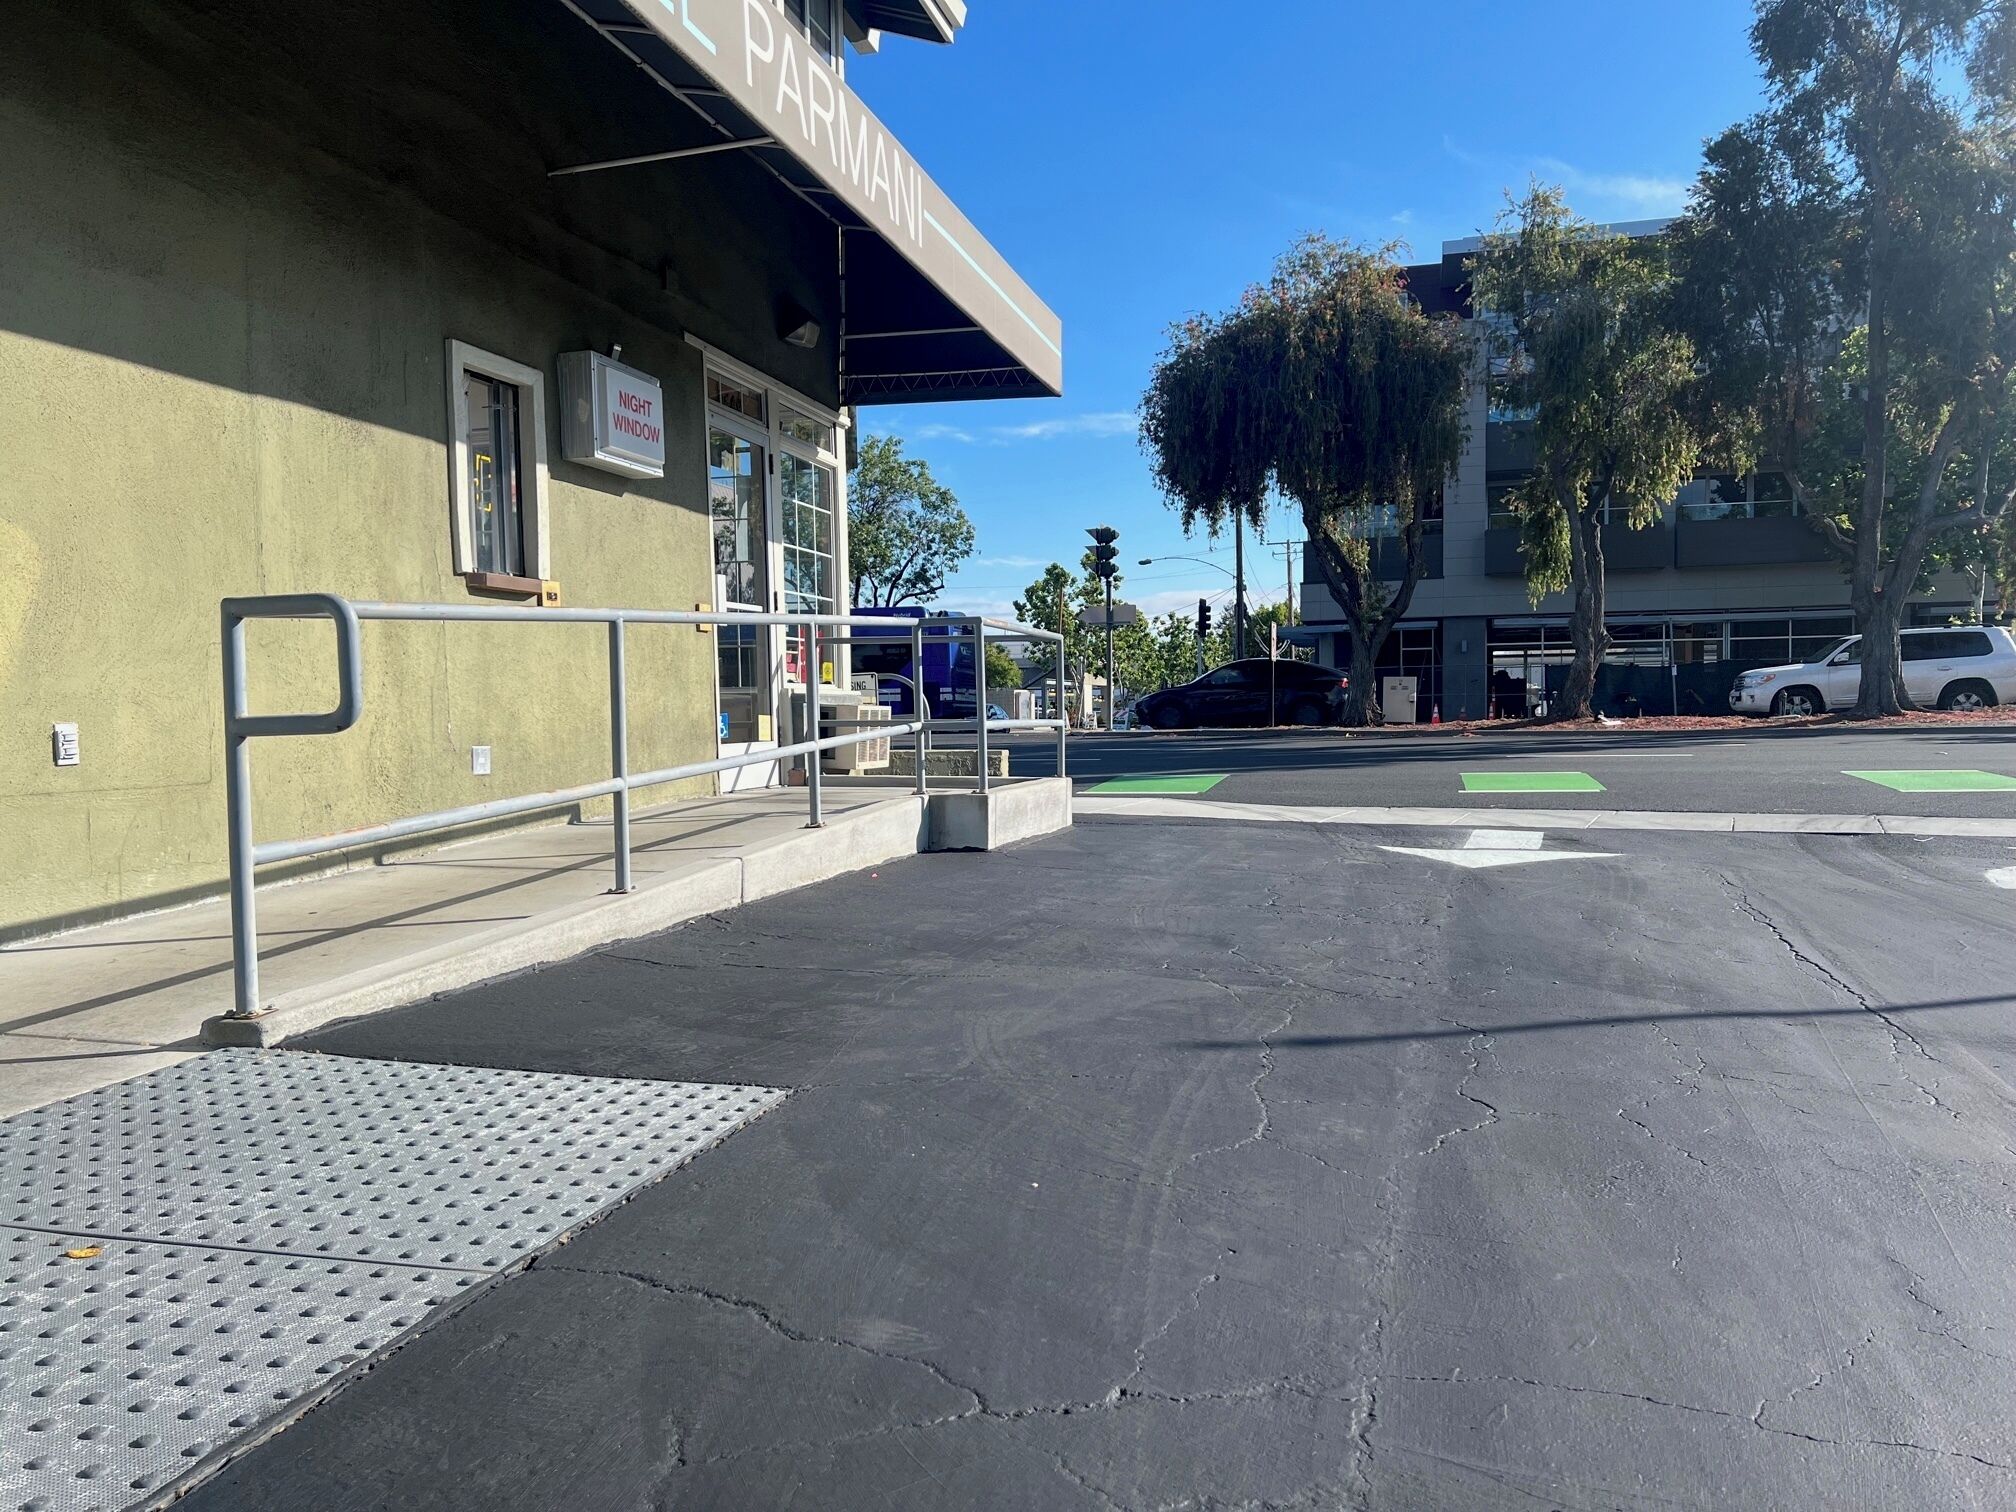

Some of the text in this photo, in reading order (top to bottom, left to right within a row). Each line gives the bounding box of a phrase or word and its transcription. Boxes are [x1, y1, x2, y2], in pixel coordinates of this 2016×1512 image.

[743, 0, 922, 247] PARMANI
[618, 390, 653, 418] NIGHT
[612, 412, 661, 444] WINDOW
